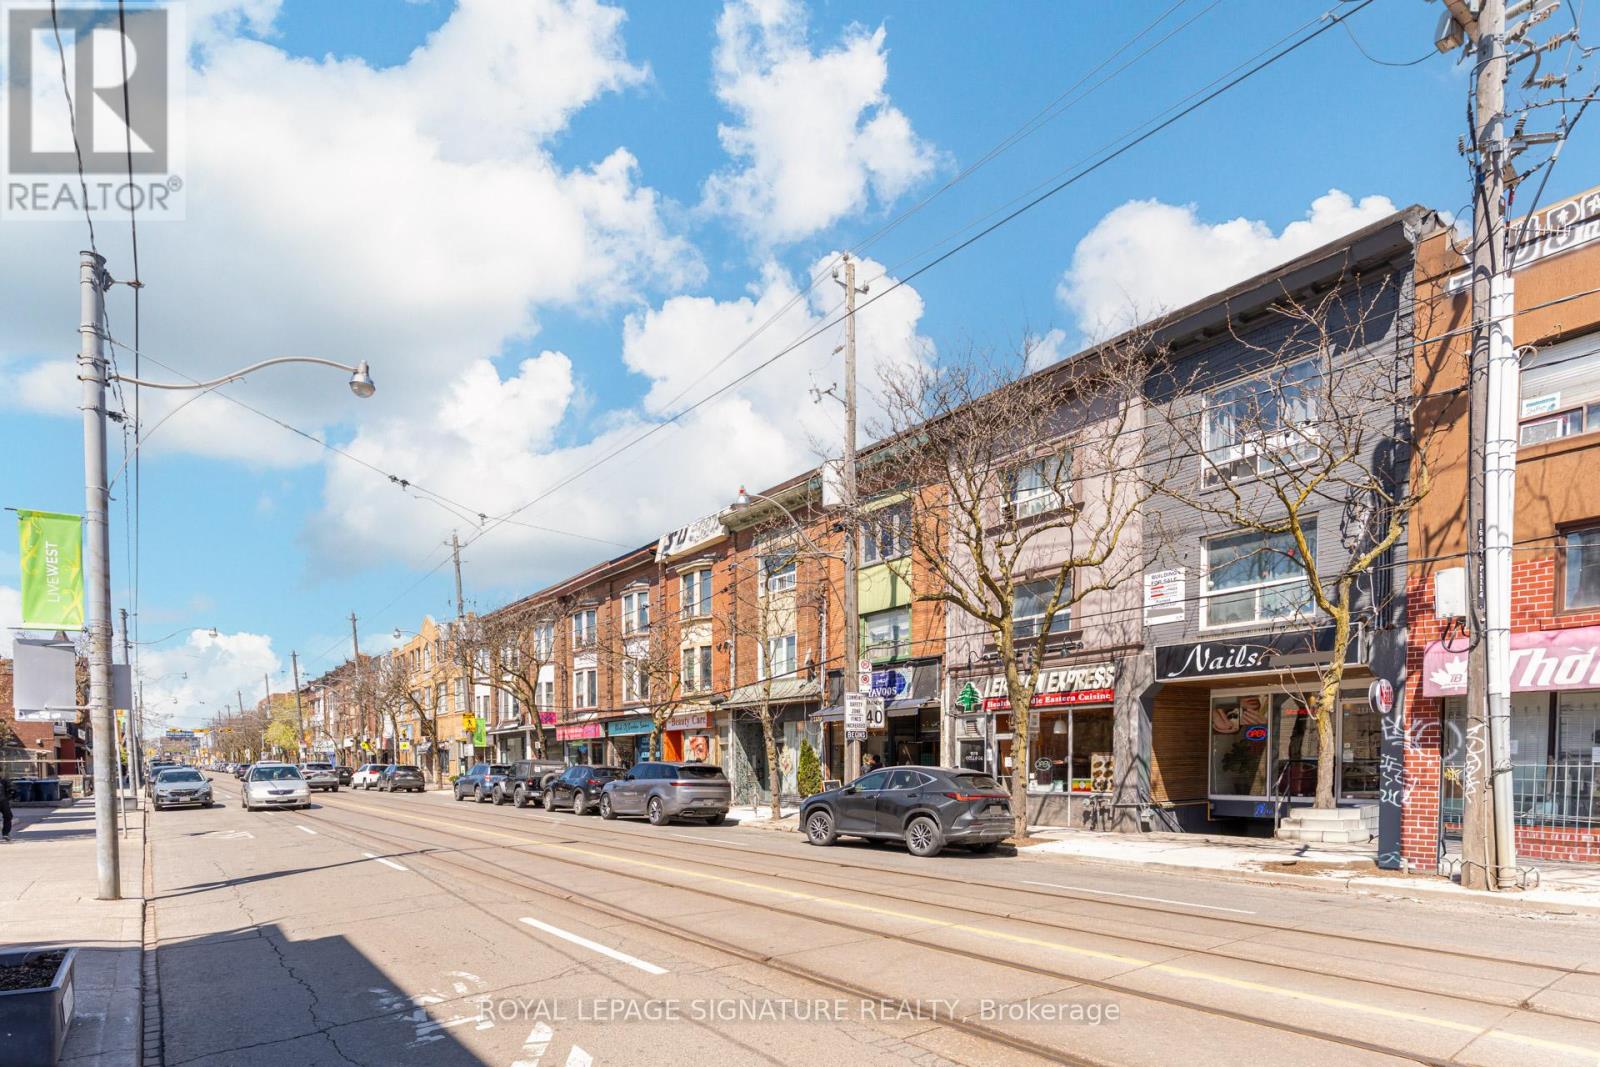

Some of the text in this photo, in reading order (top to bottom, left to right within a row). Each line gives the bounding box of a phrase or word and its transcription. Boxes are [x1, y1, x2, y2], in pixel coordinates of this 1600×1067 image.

[1046, 666, 1115, 692] EXPRESS
[1045, 694, 1076, 703] Eastern
[1078, 691, 1111, 700] Cuisine
[672, 714, 707, 727] Beauty Care
[866, 710, 883, 724] 40
